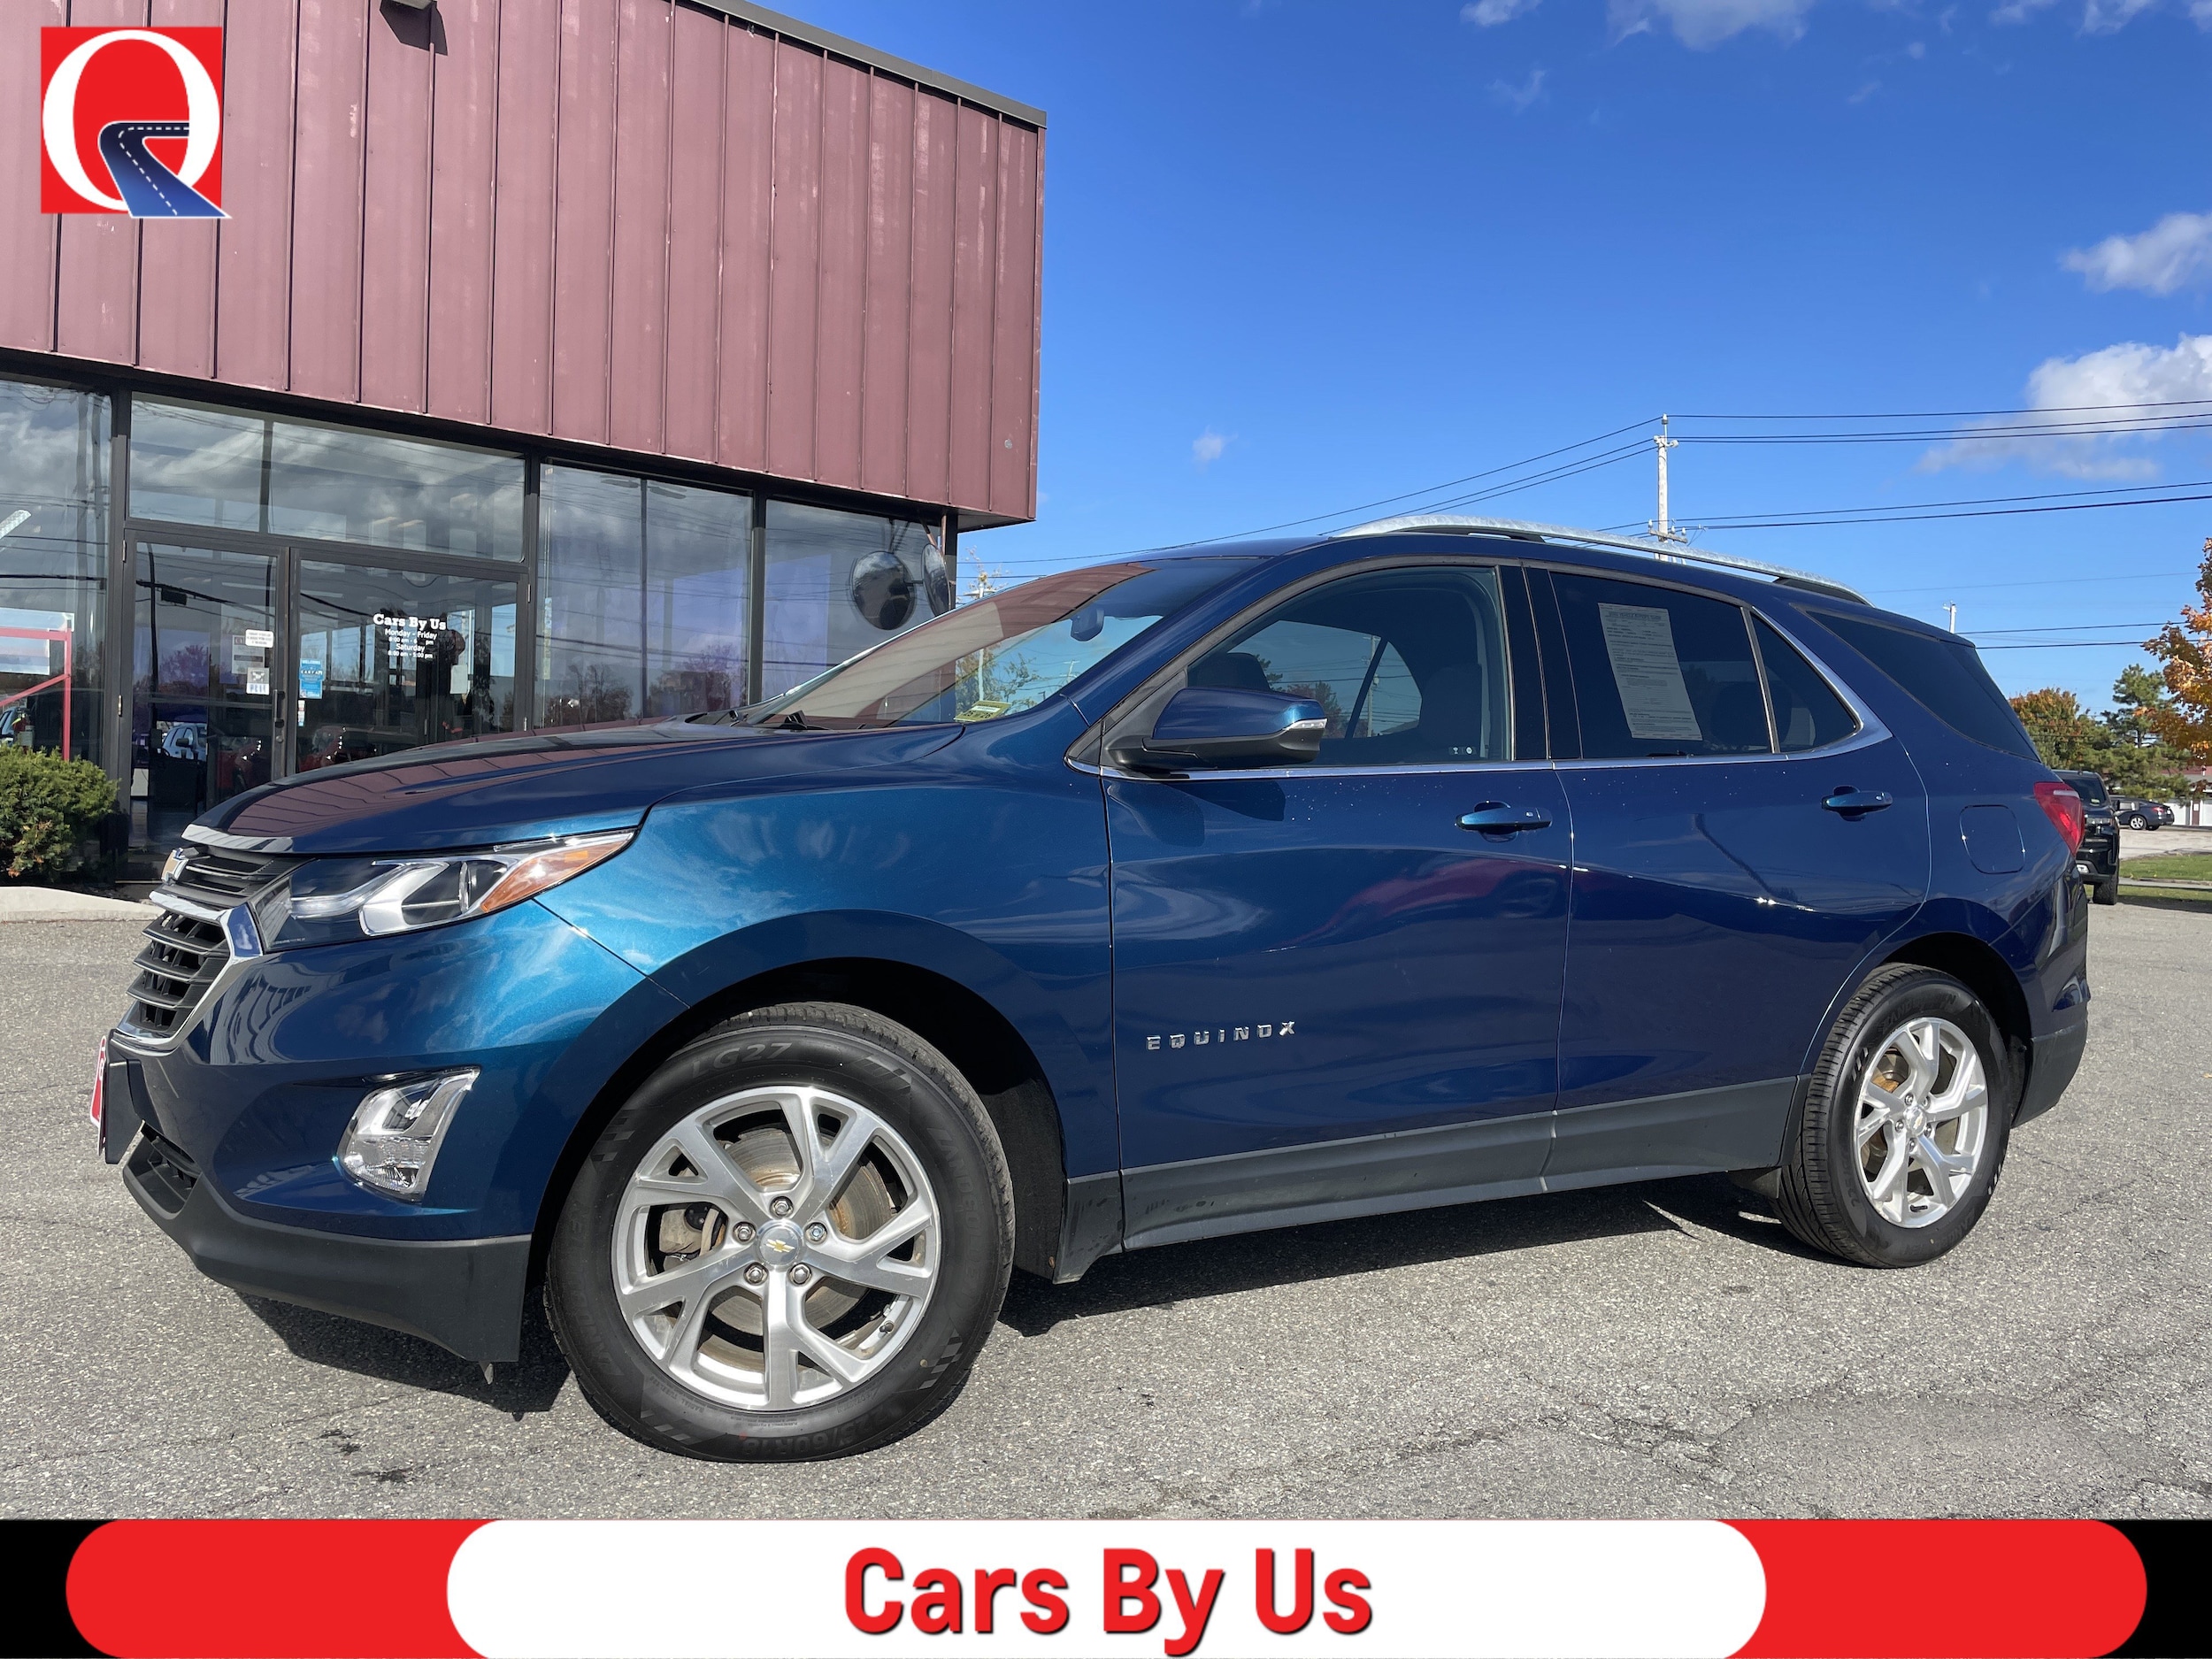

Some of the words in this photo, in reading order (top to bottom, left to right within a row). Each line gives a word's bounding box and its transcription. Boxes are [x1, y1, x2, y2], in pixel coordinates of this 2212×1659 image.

[373, 613, 405, 626] Cars
[409, 616, 427, 631] By
[429, 618, 447, 630] Us
[384, 628, 411, 637] Monday
[417, 631, 437, 640] Friday
[396, 643, 426, 652] Saturday
[1146, 1021, 1295, 1050] EQUINOX
[692, 1042, 793, 1079] LG27
